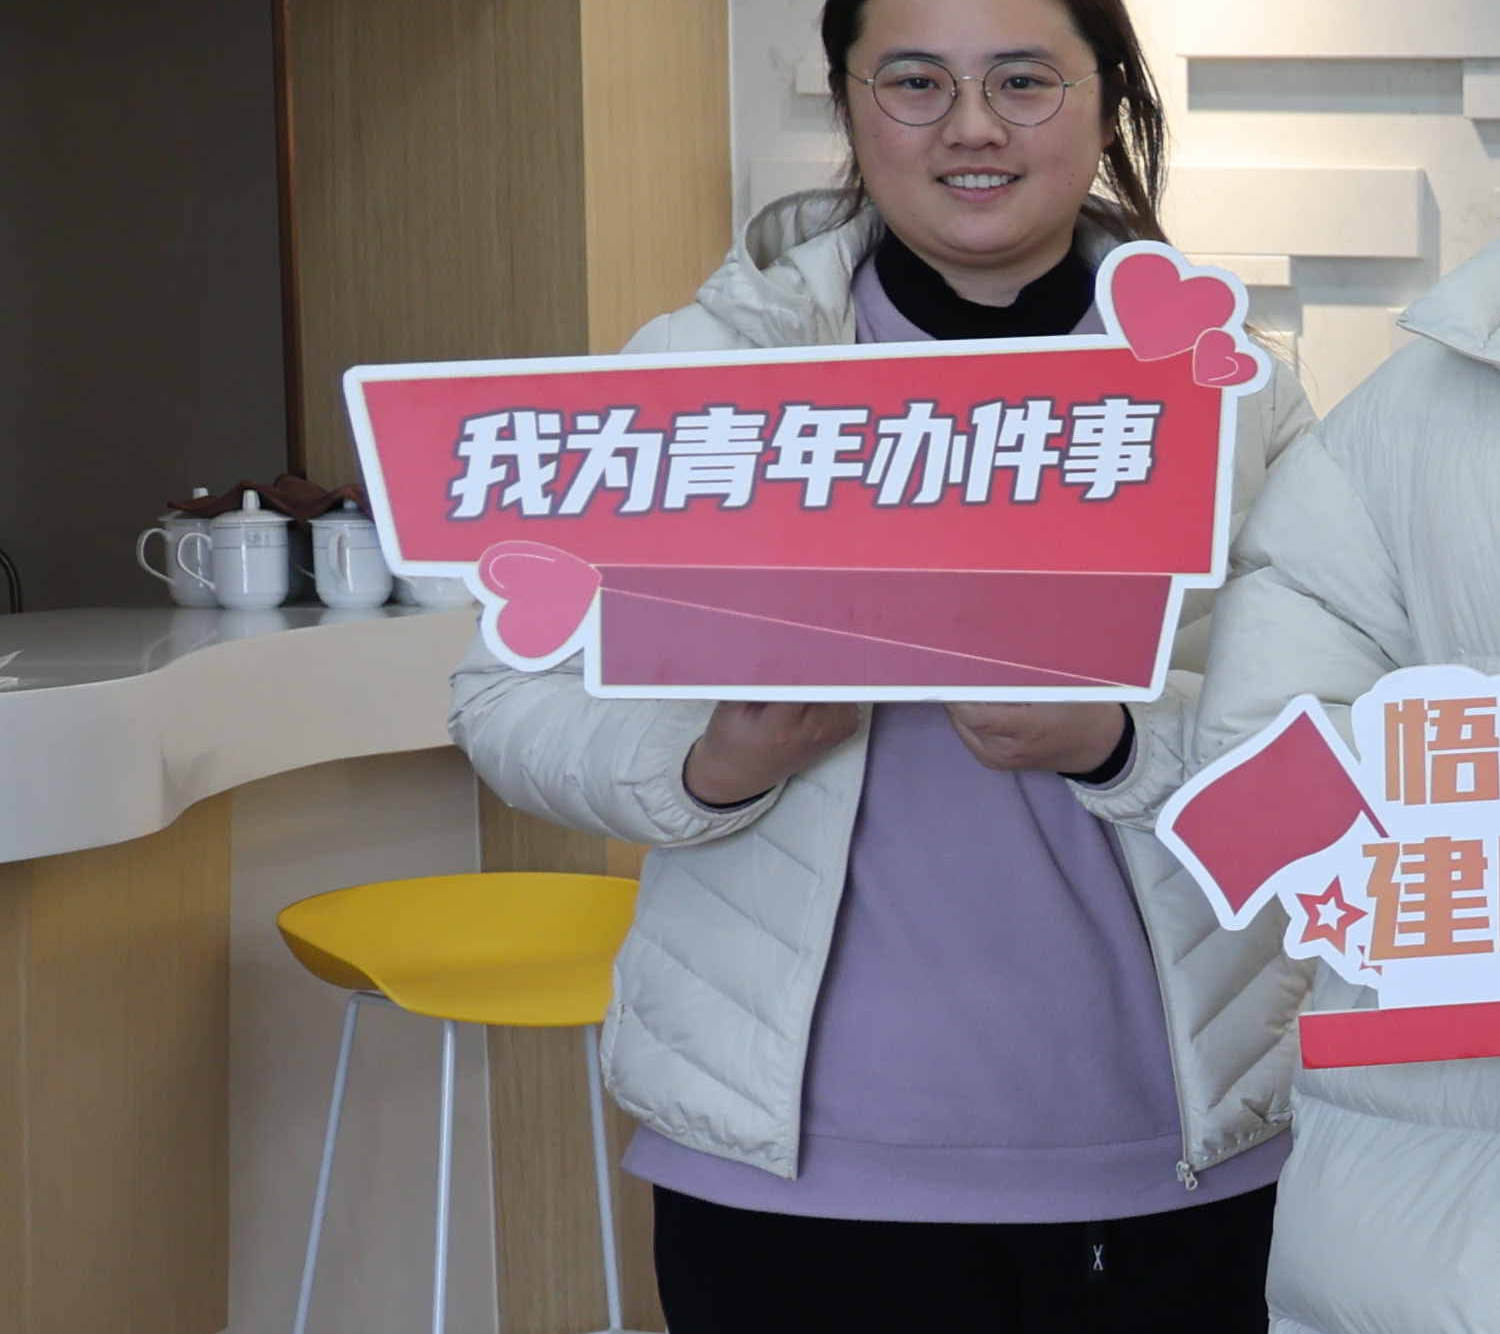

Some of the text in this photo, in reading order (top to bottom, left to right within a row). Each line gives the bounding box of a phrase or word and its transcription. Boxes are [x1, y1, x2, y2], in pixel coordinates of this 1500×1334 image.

[449, 398, 1162, 519] 我为青年办件事
